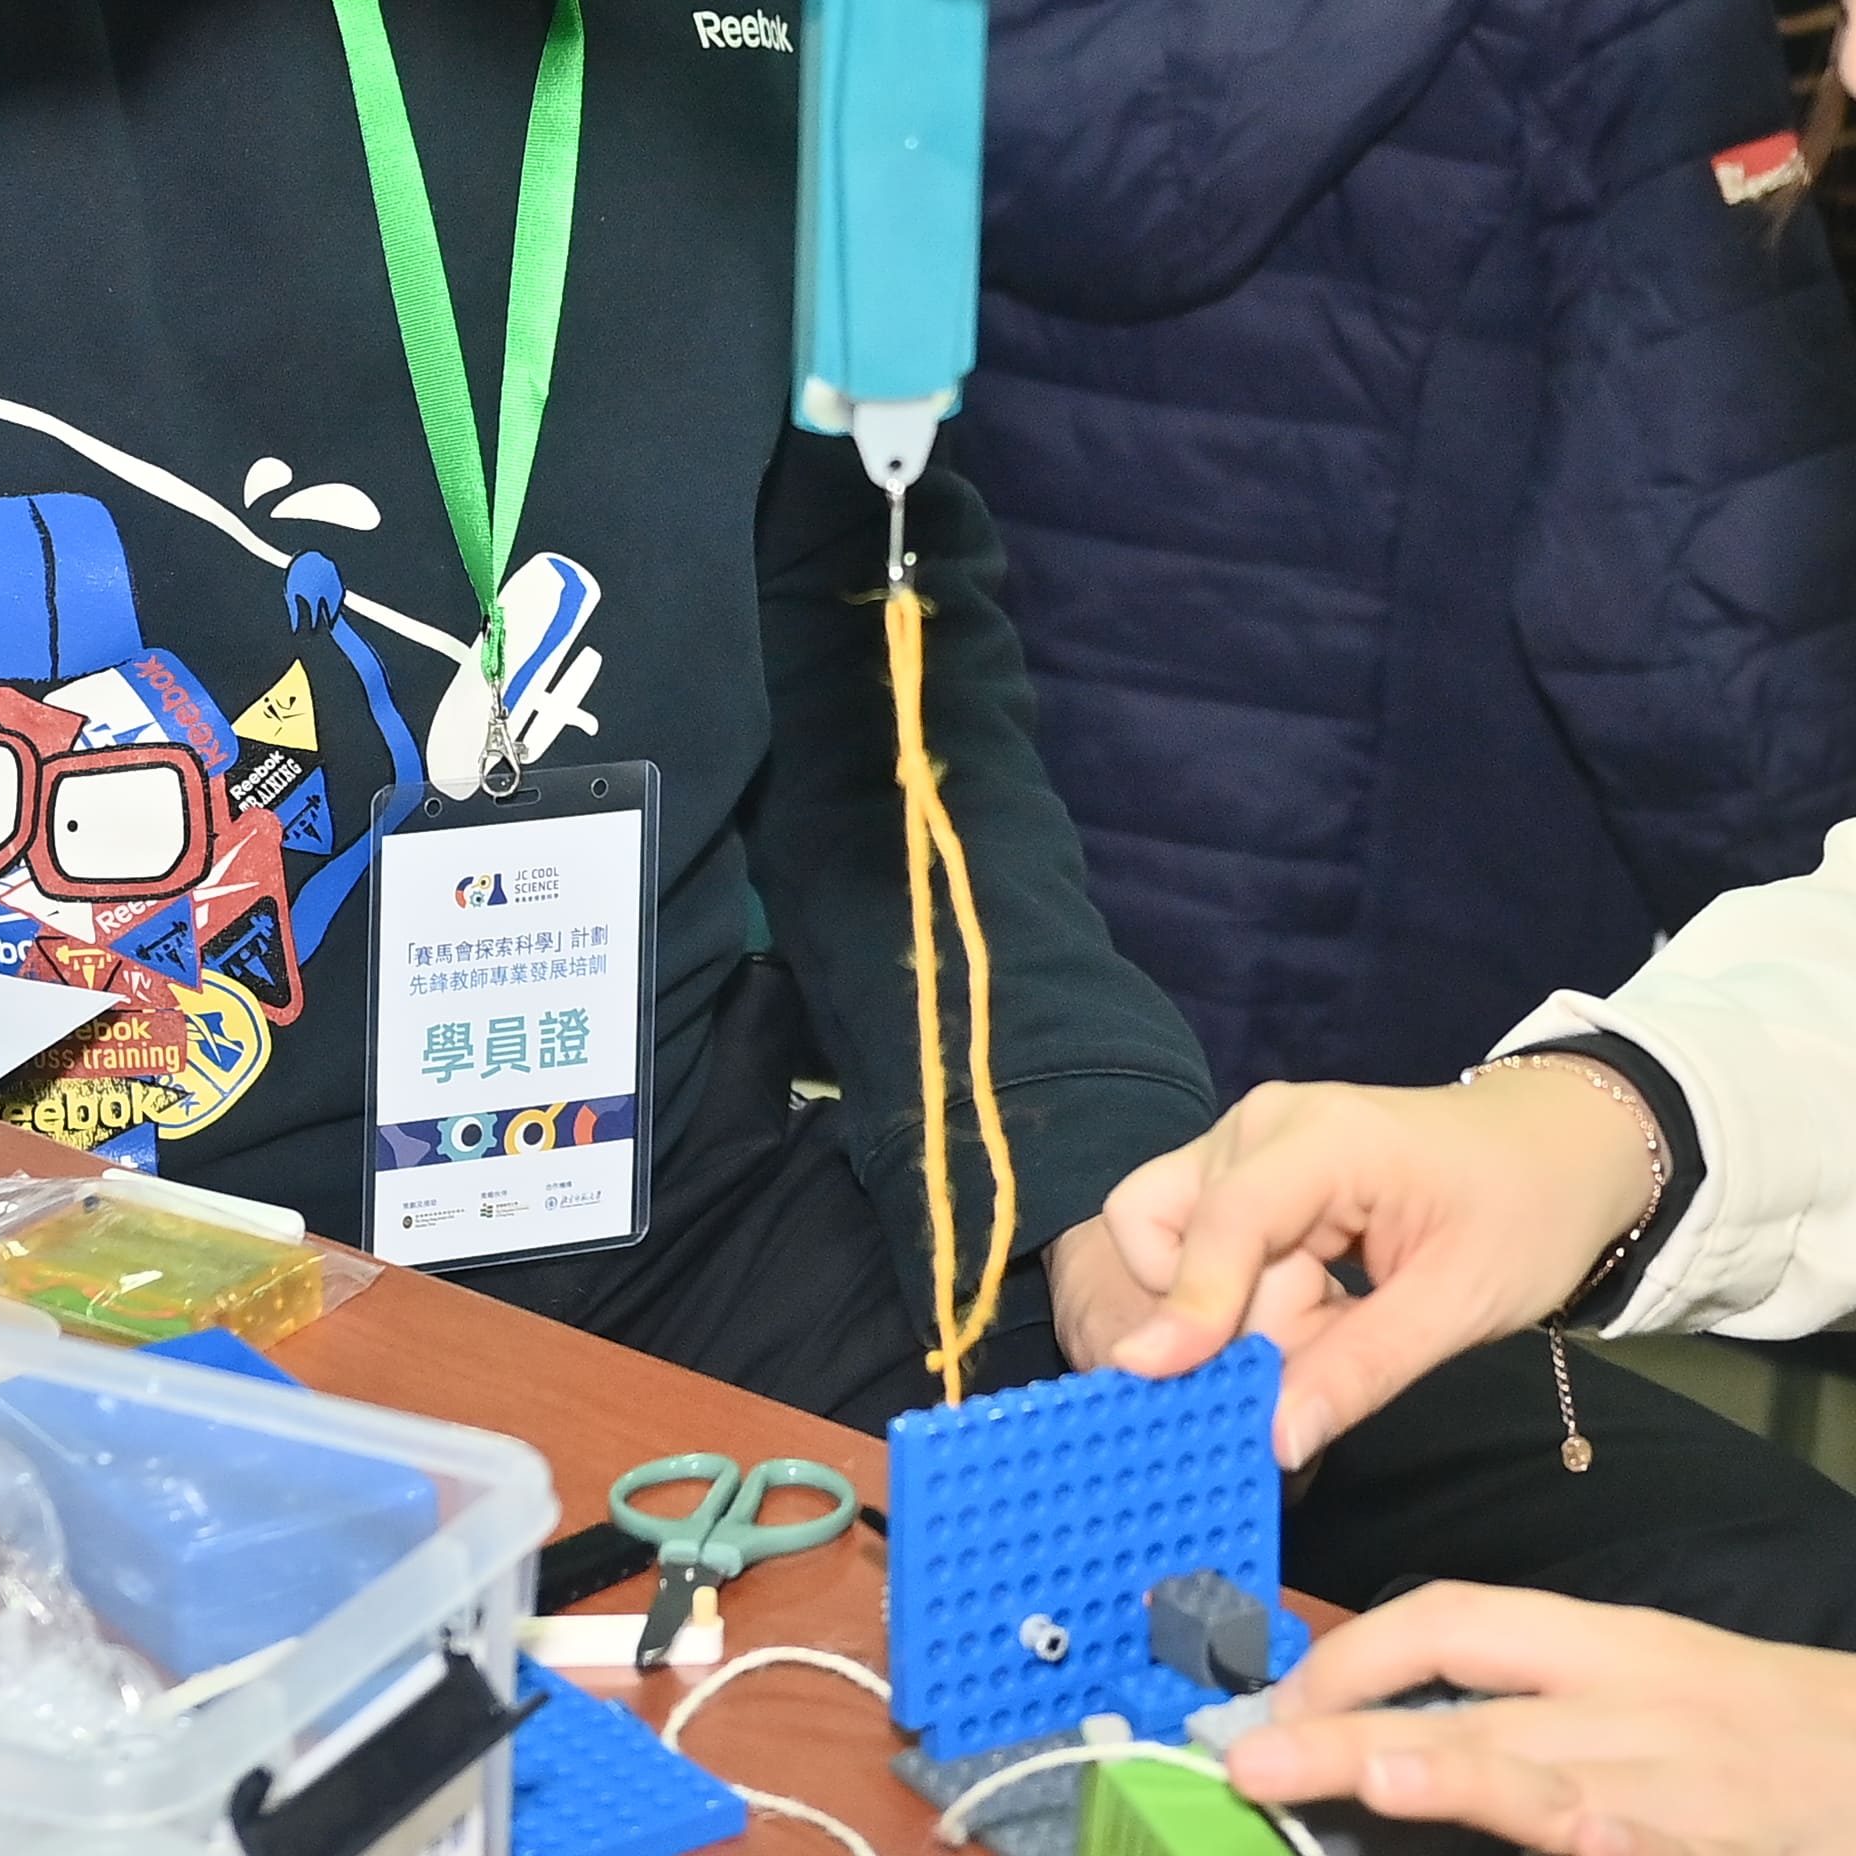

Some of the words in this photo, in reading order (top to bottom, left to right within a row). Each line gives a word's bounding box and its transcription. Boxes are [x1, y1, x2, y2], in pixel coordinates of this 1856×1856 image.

[692, 8, 794, 54] Reebok
[134, 655, 229, 770] Reebok
[229, 750, 286, 801] Reebok
[238, 758, 303, 813] TRAINING
[514, 869, 529, 882] JC
[531, 866, 560, 880] COOL
[514, 879, 560, 895] SCIENCE
[570, 923, 609, 951] 計劃
[408, 953, 609, 997] 先鋒教師專業發展培訓
[82, 1041, 181, 1073] training
[420, 1007, 592, 1085] 學員證
